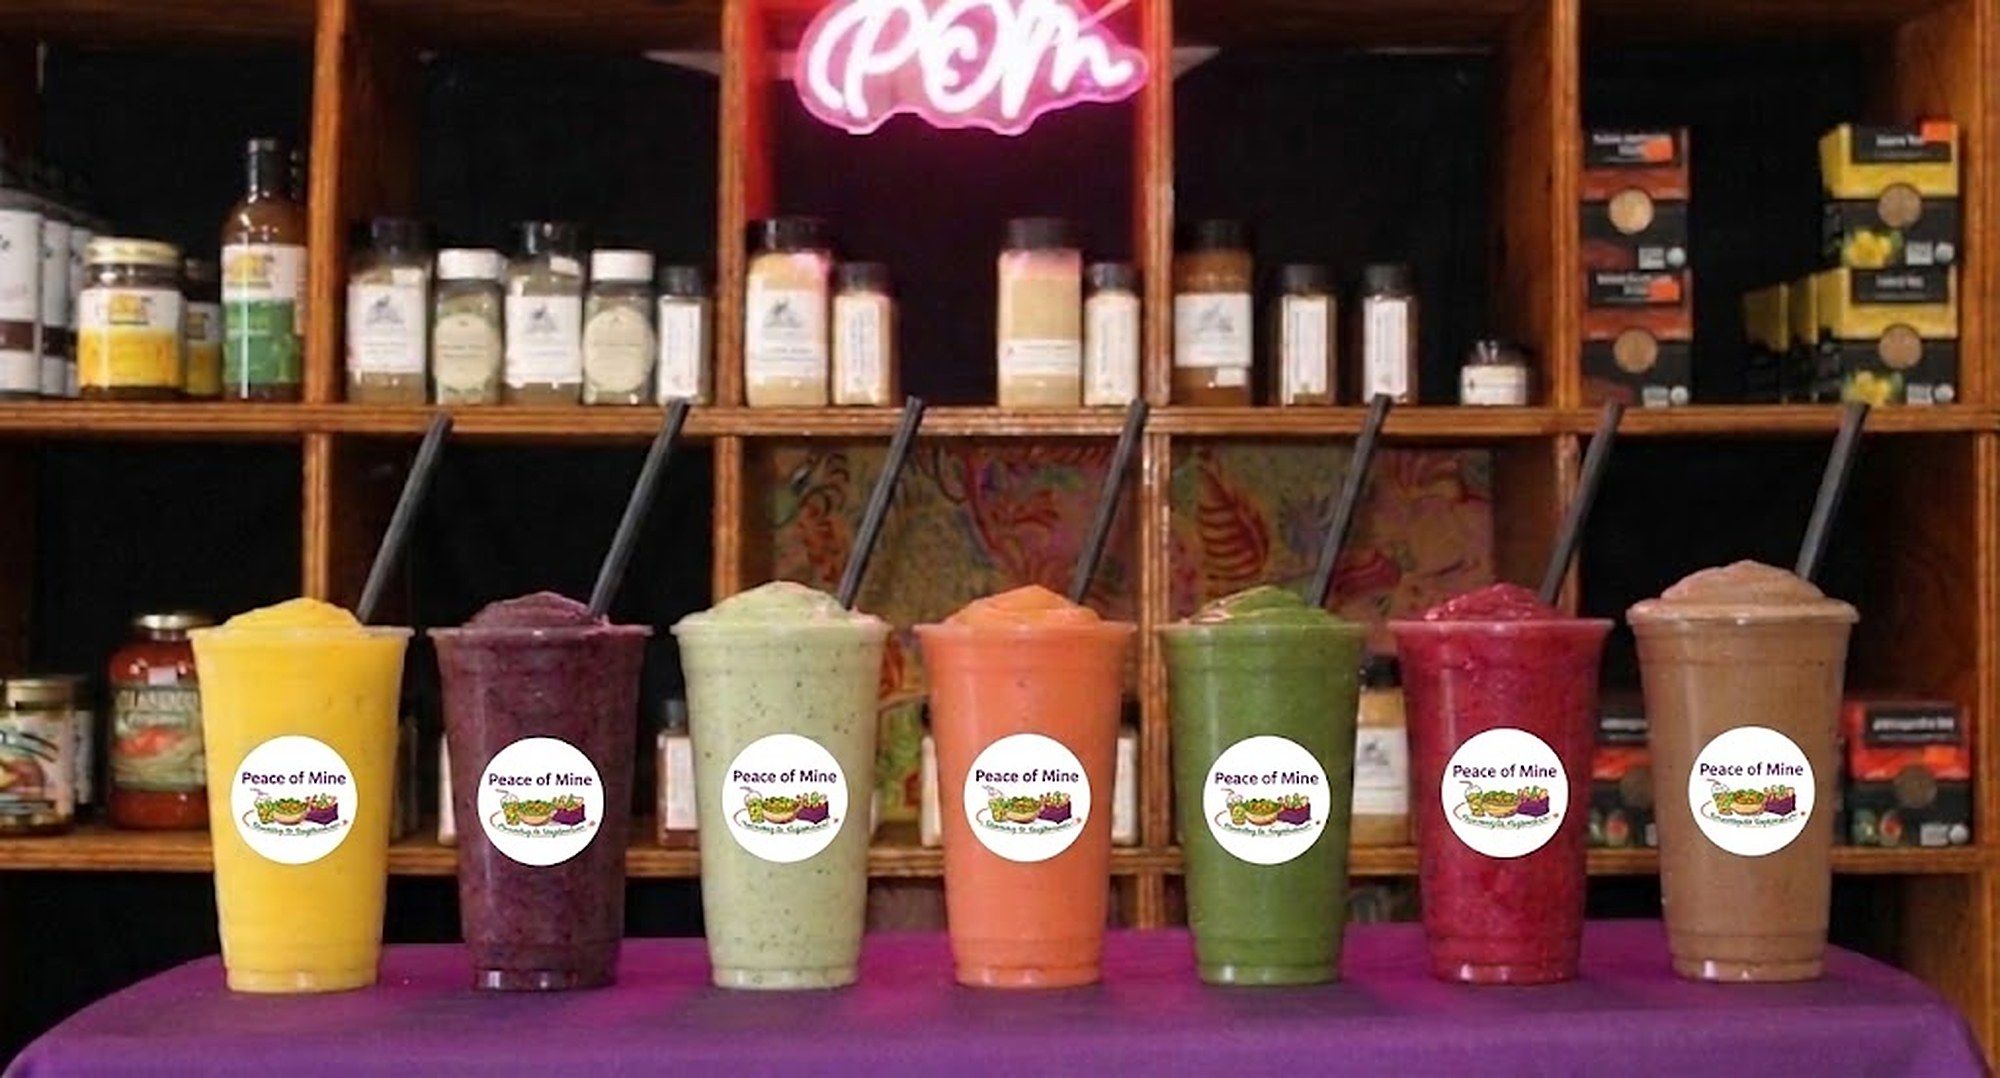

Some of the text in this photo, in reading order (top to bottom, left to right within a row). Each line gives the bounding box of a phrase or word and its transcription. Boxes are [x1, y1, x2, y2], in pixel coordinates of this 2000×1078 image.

[734, 769, 837, 783] Peace of Mine
[976, 769, 1079, 783] Peace of Mine
[1453, 764, 1557, 778] Peace of Mine
[1700, 762, 1803, 776] Peace of Mine
[242, 771, 346, 785] Peace of Mine
[489, 773, 592, 786] Peace of Mine
[1215, 771, 1319, 785] Peace of Mine
